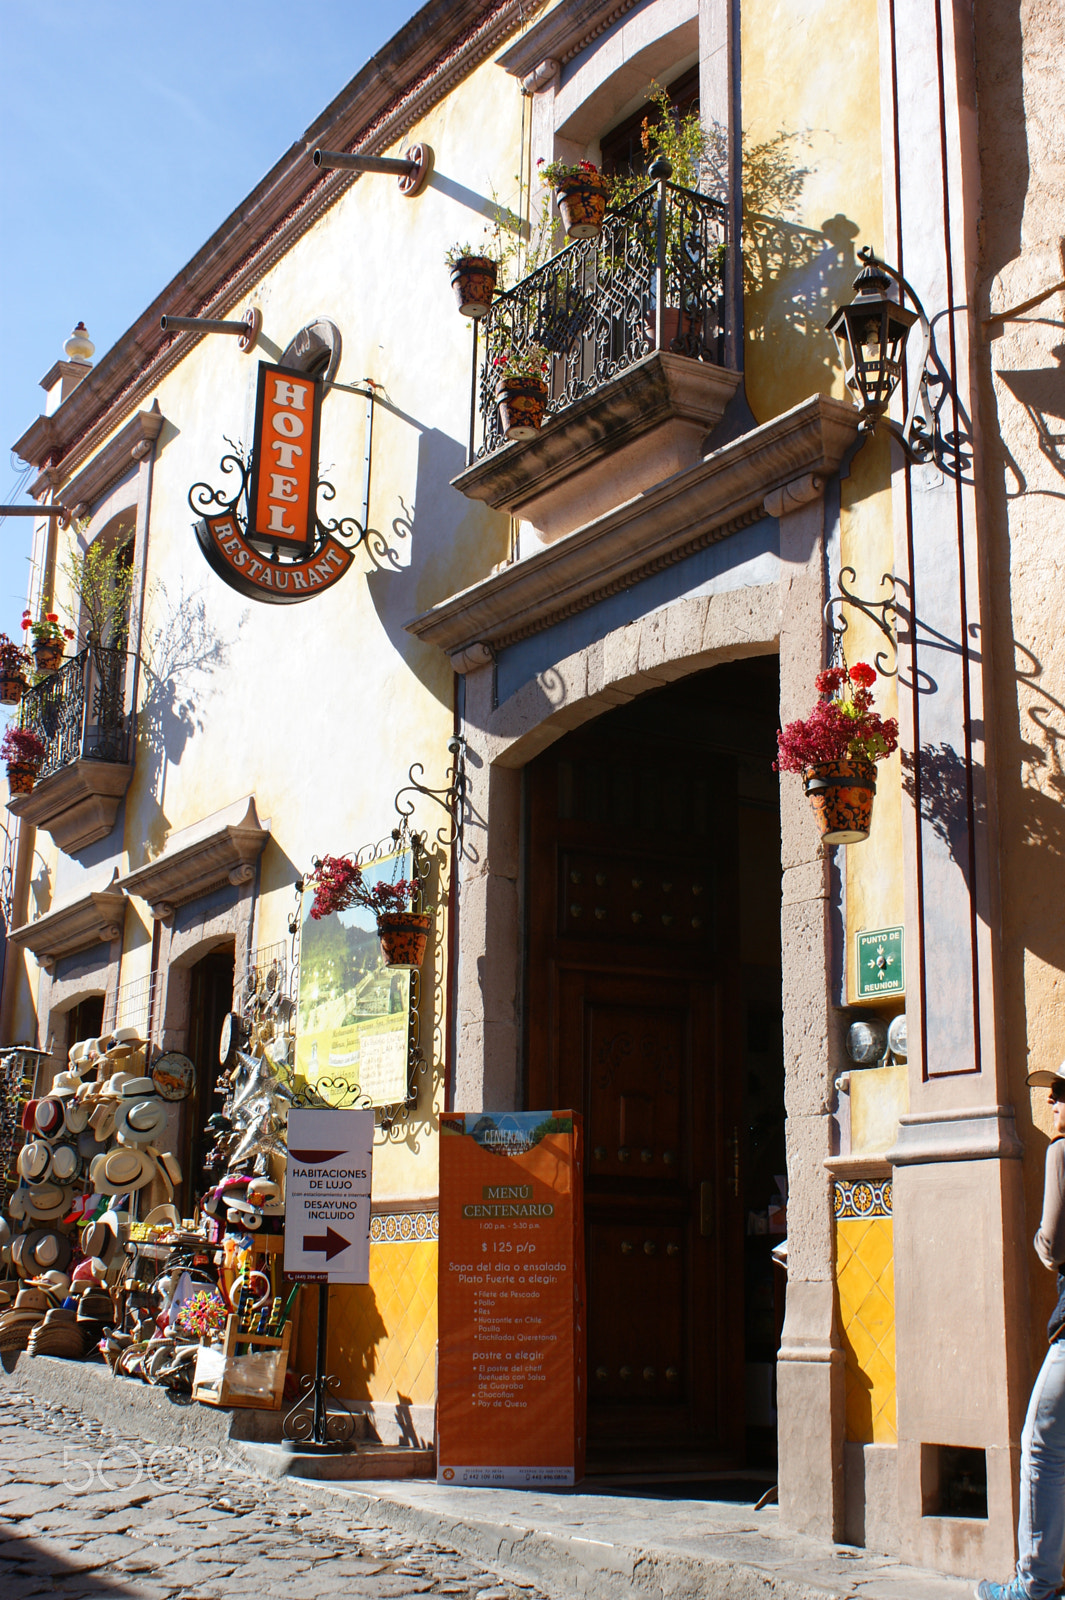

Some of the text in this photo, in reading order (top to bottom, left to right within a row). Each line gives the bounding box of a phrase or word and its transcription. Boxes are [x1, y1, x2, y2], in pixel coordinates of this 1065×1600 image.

[267, 380, 308, 535] HOTEL
[214, 522, 344, 589] RESTAURANT
[862, 931, 900, 945] PUNTO DE
[292, 1169, 367, 1179] HABITACIONES
[309, 1181, 353, 1190] DE LUJO
[488, 1185, 529, 1199] MENÚ
[304, 1200, 358, 1210] DESAYUNO
[308, 1211, 355, 1220] INCLUIDO
[464, 1204, 554, 1217] CENTENARIO
[481, 1242, 536, 1254] $ 125 p/p
[449, 1262, 473, 1273] Sopa
[476, 1262, 492, 1272] del
[513, 1264, 521, 1272] o
[523, 1262, 567, 1272] ensalada
[458, 1274, 558, 1285] Plato Fuerte a elegir:
[524, 1316, 542, 1324] Chile
[472, 1353, 502, 1361] postre
[514, 1351, 545, 1361] elegir:
[511, 1364, 523, 1372] del
[527, 1373, 546, 1381] Salsa
